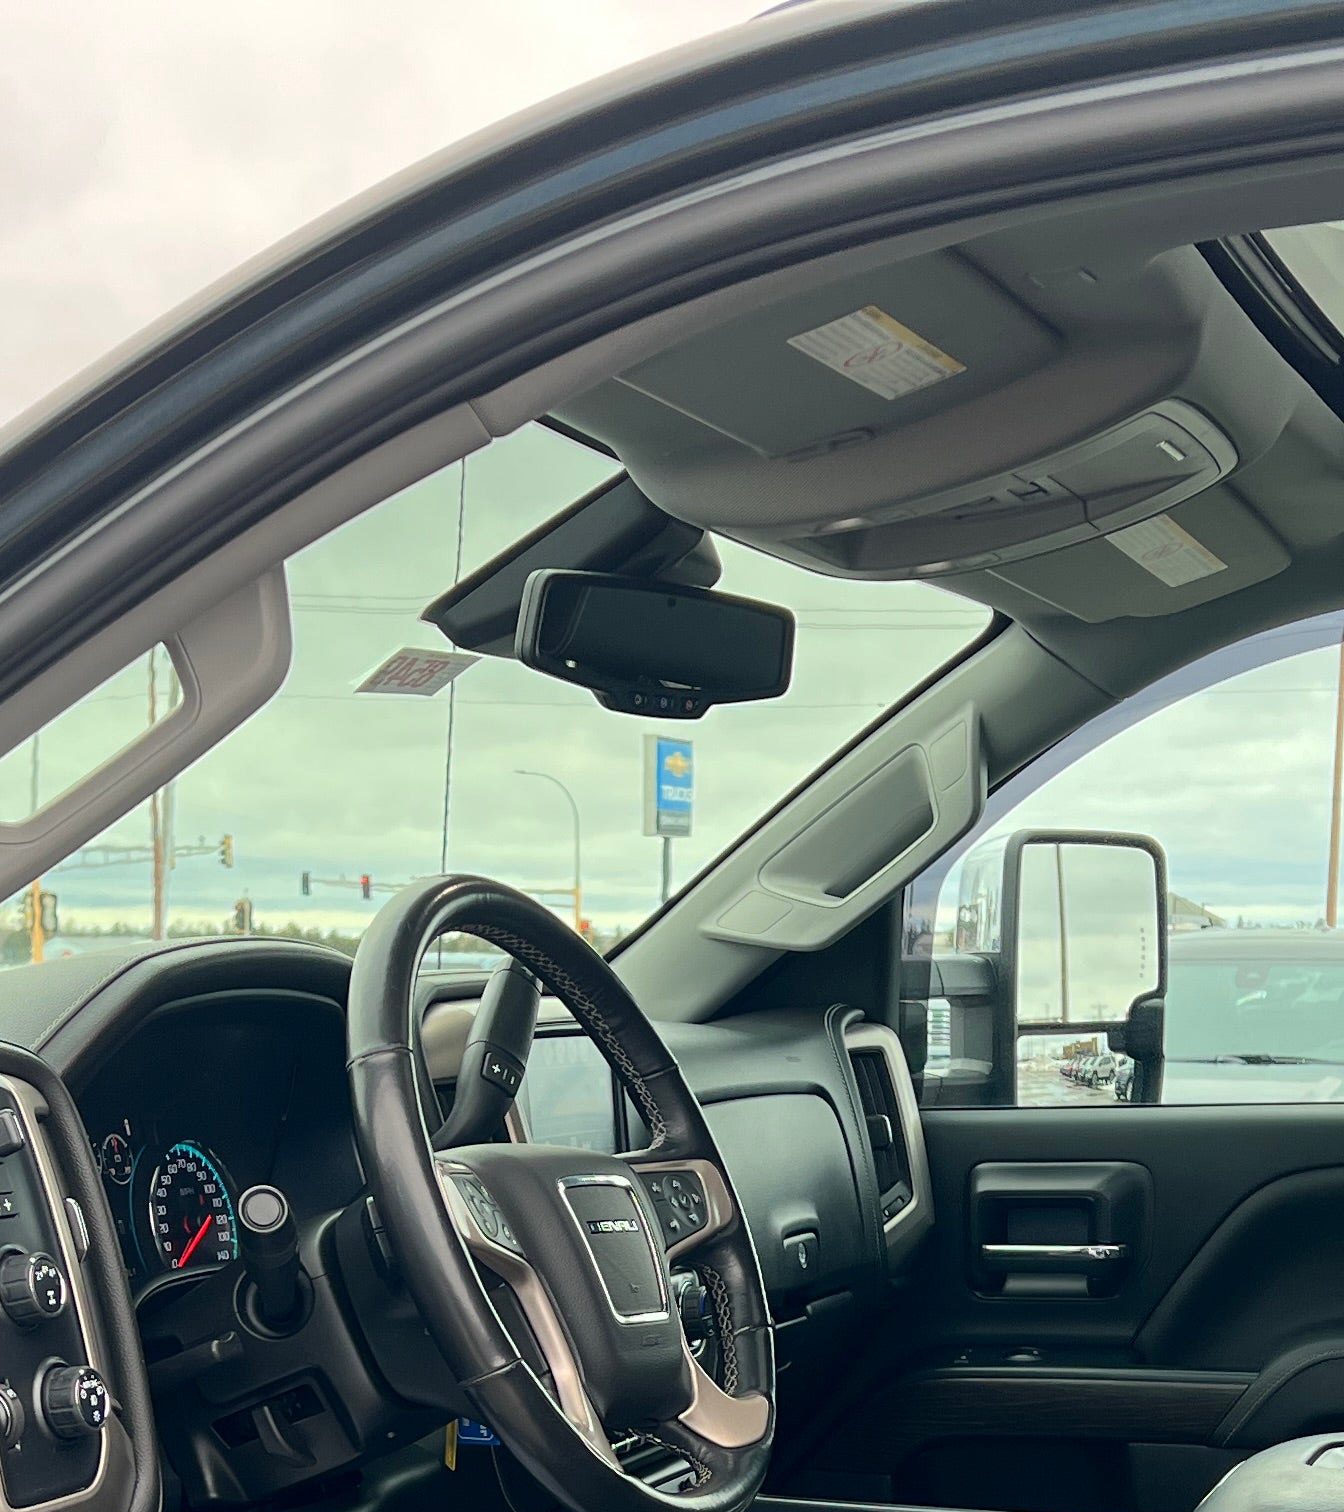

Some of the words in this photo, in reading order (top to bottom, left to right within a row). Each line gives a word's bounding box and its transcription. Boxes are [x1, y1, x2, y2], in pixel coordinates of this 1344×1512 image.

[187, 1162, 197, 1172] 80
[161, 1175, 172, 1185] 50
[196, 1171, 207, 1181] 90
[203, 1184, 216, 1194] 100
[156, 1205, 167, 1215] 30
[216, 1215, 227, 1225] 120
